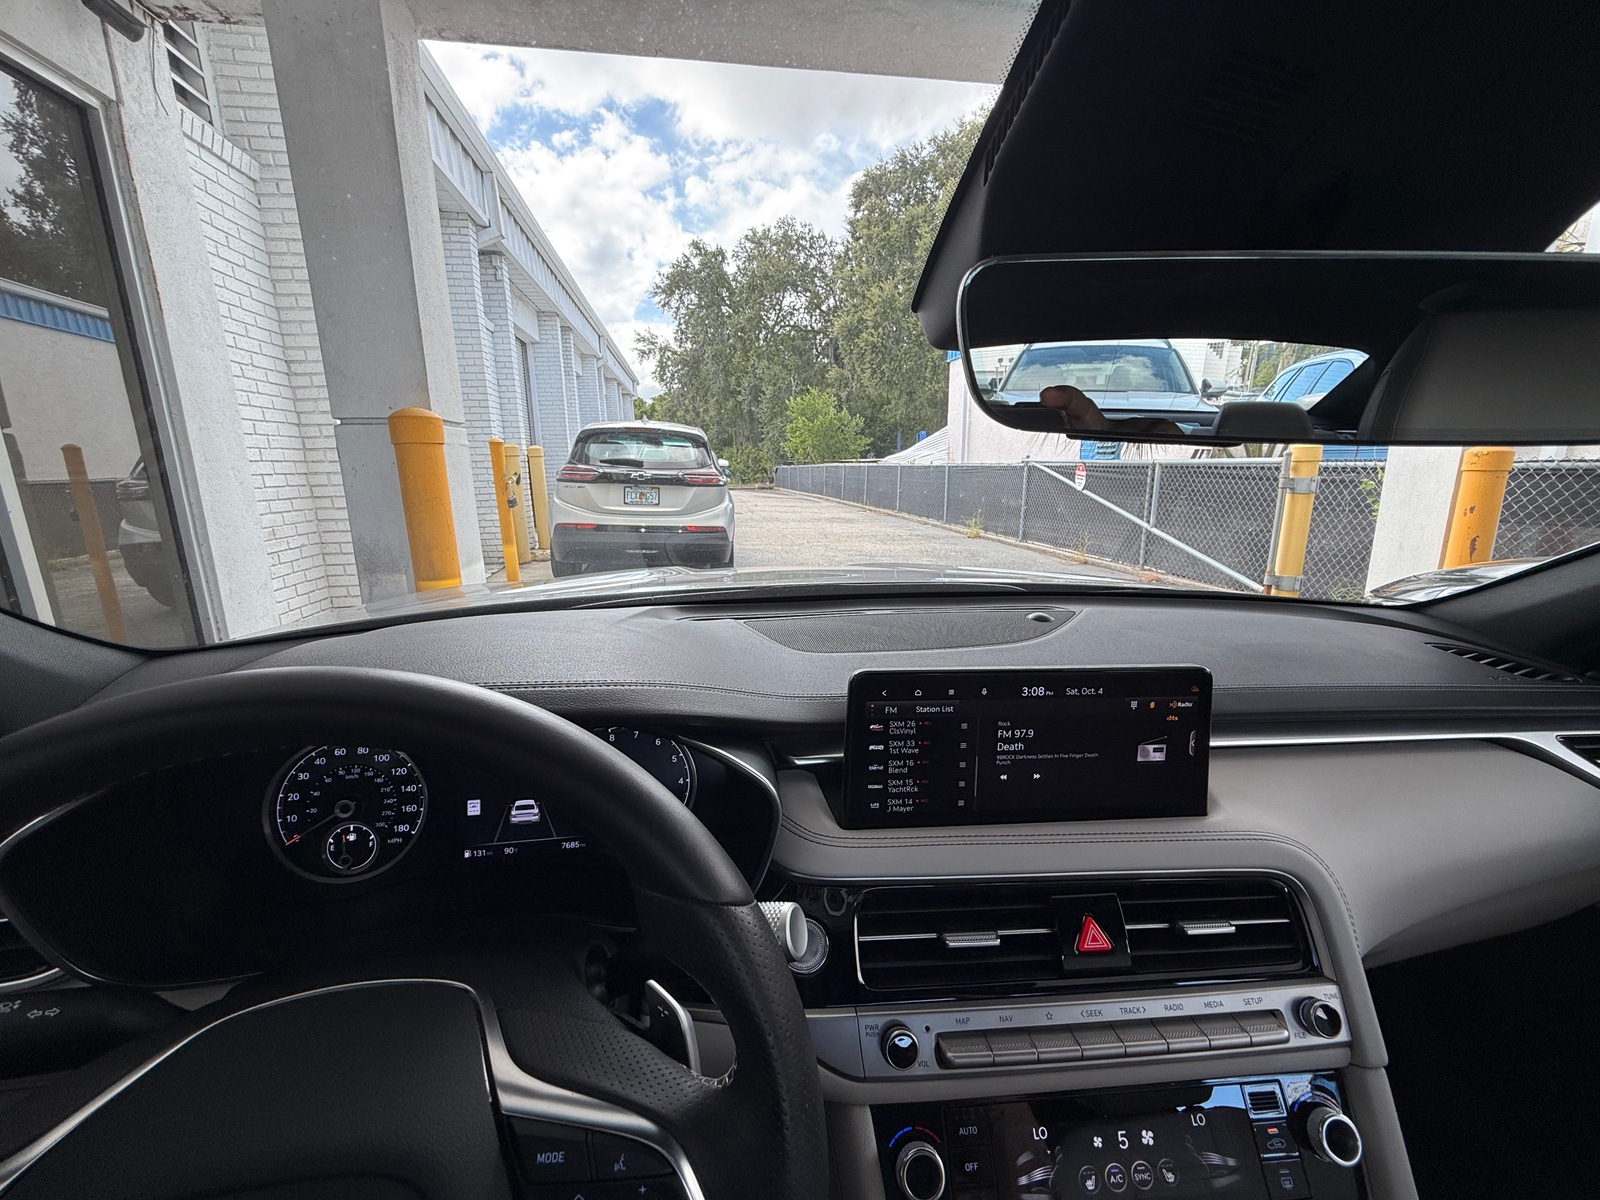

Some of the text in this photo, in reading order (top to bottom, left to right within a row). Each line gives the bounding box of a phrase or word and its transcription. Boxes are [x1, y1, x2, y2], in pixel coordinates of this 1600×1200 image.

[1022, 687, 1045, 696] 3:08
[633, 730, 639, 738] 7
[888, 728, 916, 736] ClsVinyl
[997, 729, 1034, 738] FM 97.9
[609, 734, 615, 742] 8
[357, 746, 369, 754] 80
[996, 742, 1024, 750] Death
[334, 747, 346, 756] 60
[314, 757, 326, 765] 40
[374, 754, 390, 762] 100
[672, 754, 678, 762] 5
[297, 772, 310, 780] 30
[391, 768, 408, 776] 120
[678, 776, 684, 784] 4
[400, 784, 417, 793] 140
[288, 793, 300, 801] 20
[401, 804, 418, 813] 160
[286, 814, 298, 822] 10
[394, 824, 410, 832] 180
[1324, 992, 1339, 1000] TUNE
[955, 1017, 971, 1026] MAP
[1000, 1014, 1014, 1023] NAV
[1164, 1003, 1184, 1012] RADIO
[1204, 1000, 1224, 1008] MEDIA
[1242, 996, 1264, 1006] SETUP
[1190, 1113, 1206, 1126] LO
[958, 1126, 978, 1136] AUTO
[1032, 1126, 1048, 1140] LO
[1117, 1130, 1129, 1150] 5
[536, 1152, 566, 1164] MODE
[964, 1162, 979, 1172] OFF
[1110, 1174, 1124, 1184] A/C
[1134, 1172, 1152, 1181] SYNC
